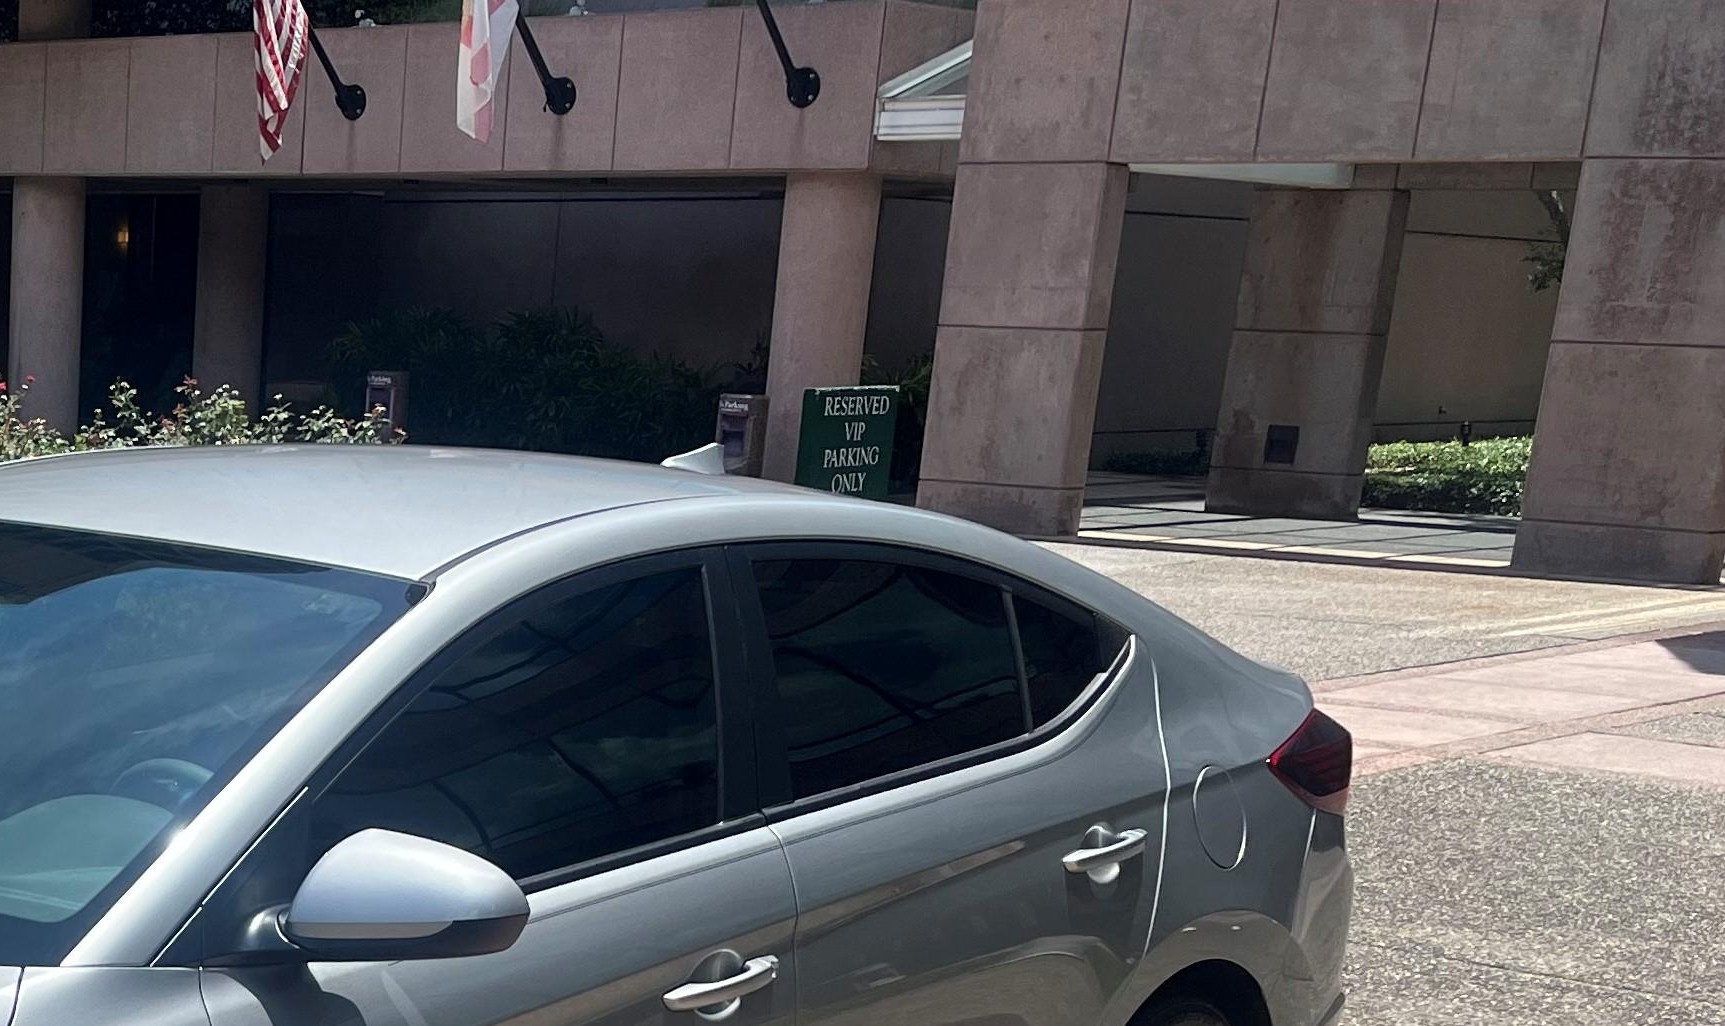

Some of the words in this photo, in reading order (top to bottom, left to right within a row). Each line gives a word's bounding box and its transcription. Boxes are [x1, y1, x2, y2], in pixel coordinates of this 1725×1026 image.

[824, 395, 890, 416] RESERVED
[844, 421, 866, 441] VIP
[823, 446, 880, 468] PARKING
[831, 472, 867, 493] ONLY
